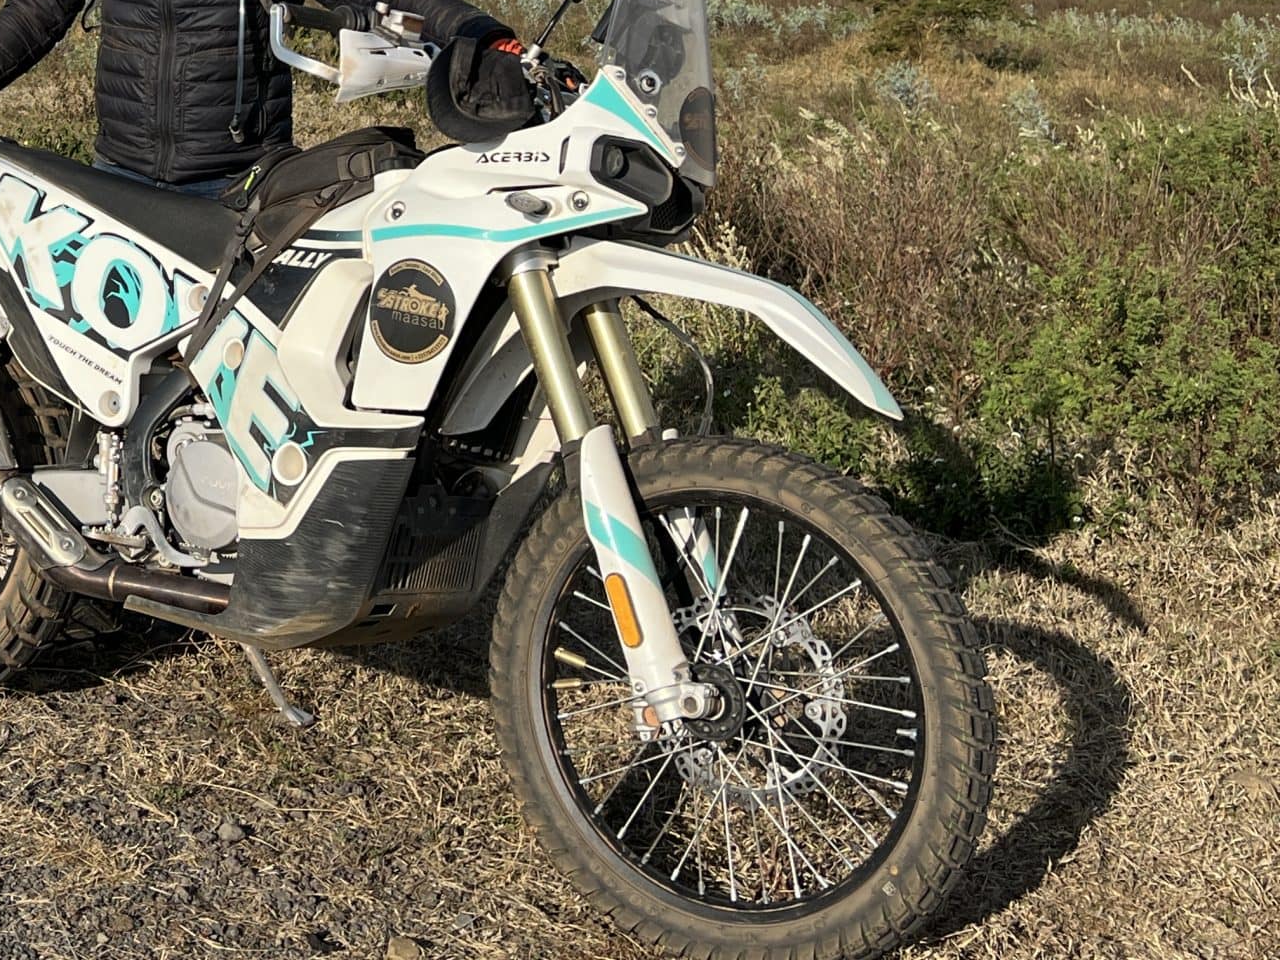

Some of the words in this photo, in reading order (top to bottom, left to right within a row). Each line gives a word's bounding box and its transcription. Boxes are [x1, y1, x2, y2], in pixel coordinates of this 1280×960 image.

[271, 248, 334, 269] ALLY
[49, 336, 77, 355] TOUCH
[79, 353, 95, 367] THE
[94, 365, 122, 384] DREAM
